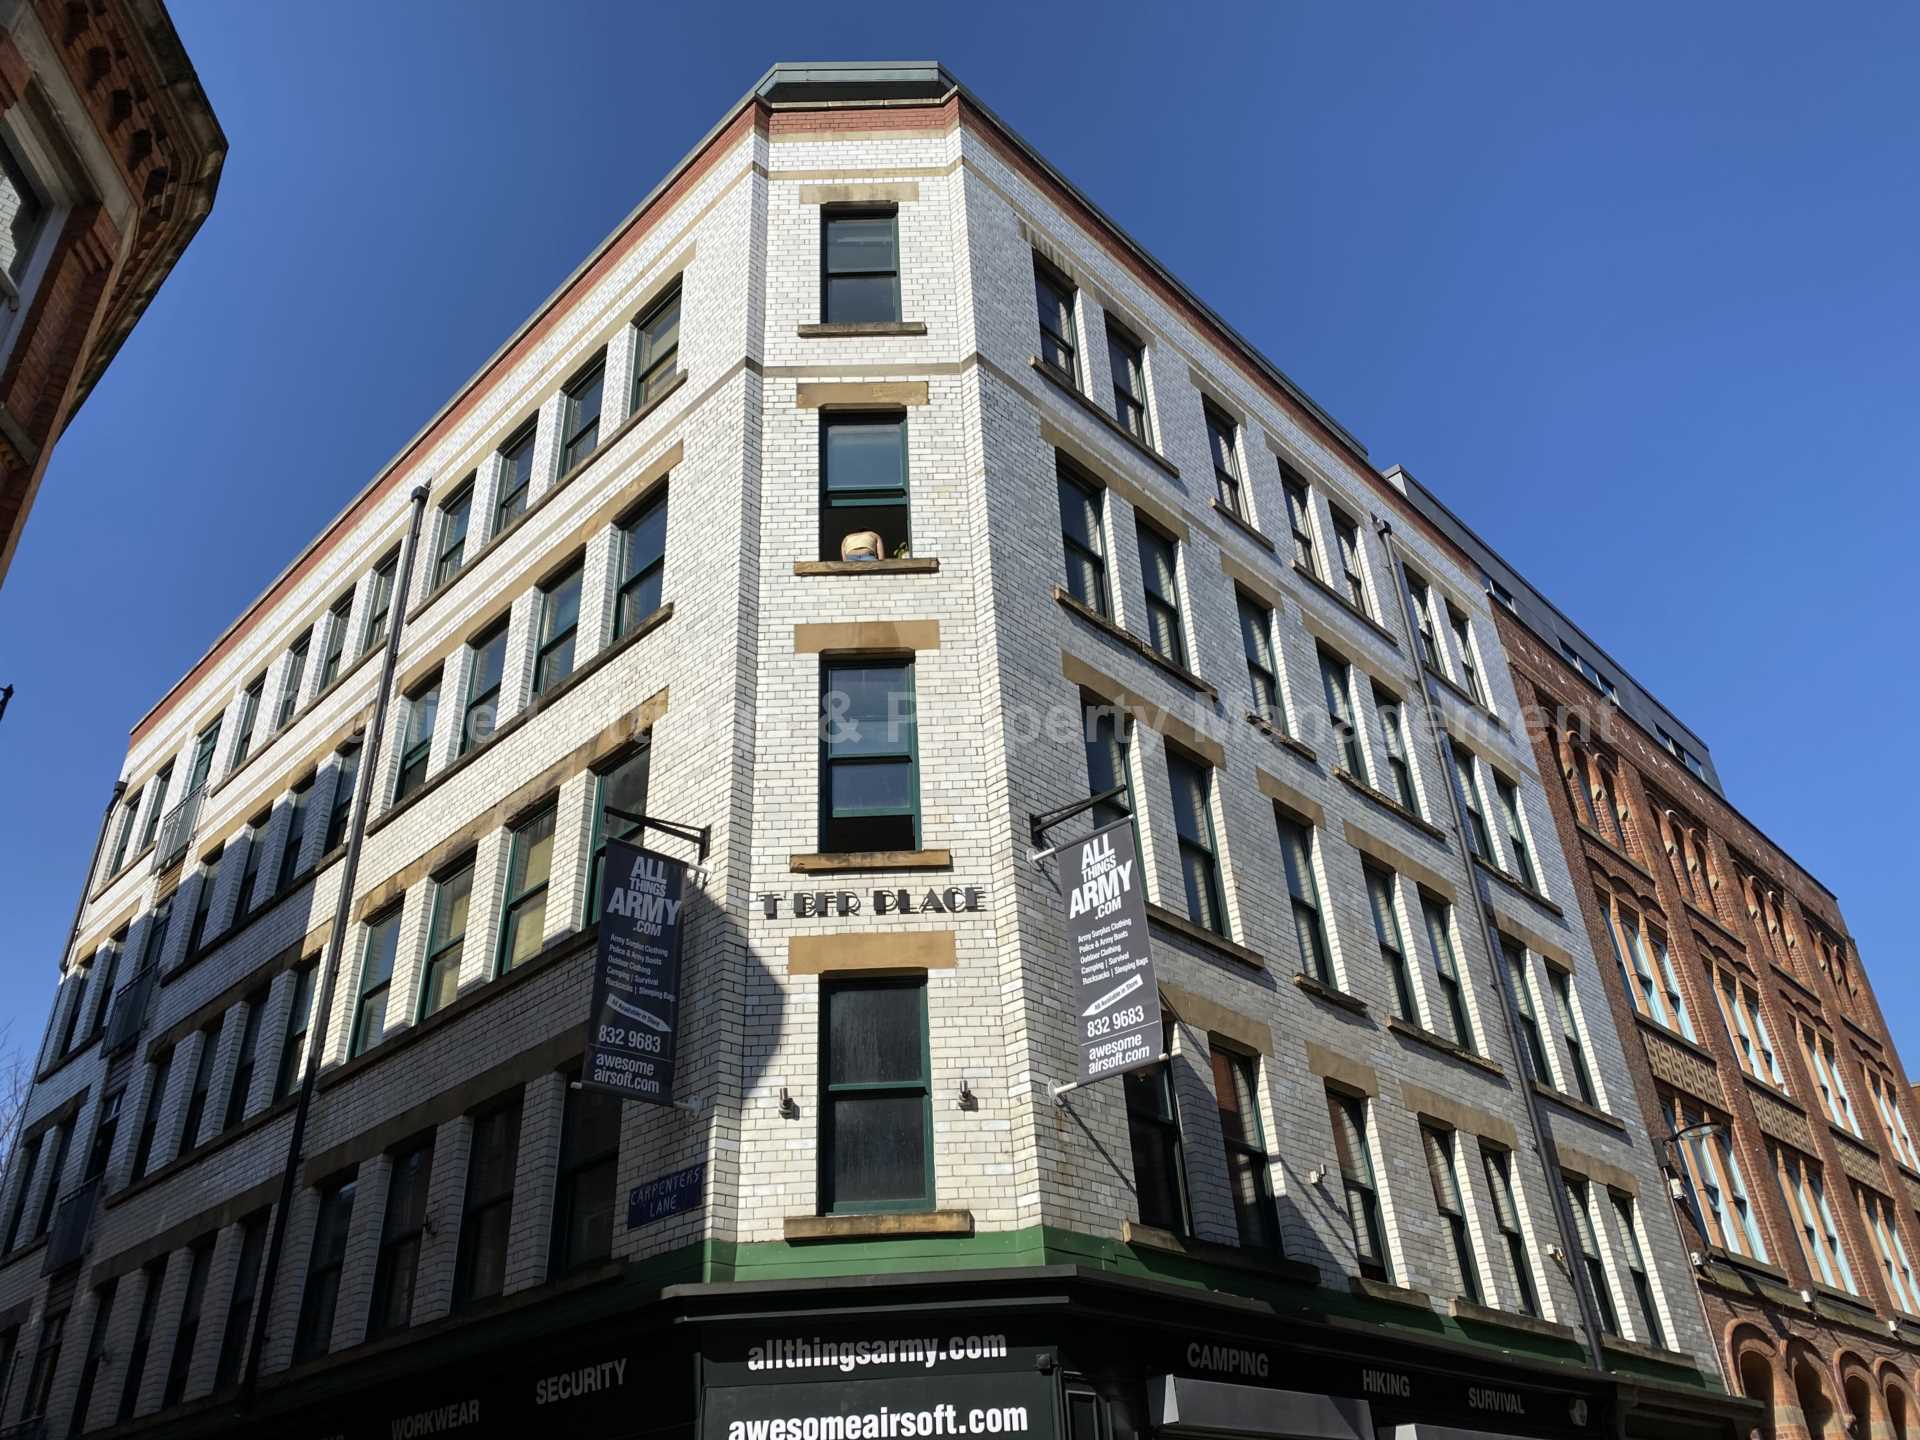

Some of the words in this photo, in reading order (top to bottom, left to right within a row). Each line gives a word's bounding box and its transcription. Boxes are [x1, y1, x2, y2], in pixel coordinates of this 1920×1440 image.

[1081, 832, 1115, 869] ALL
[631, 855, 667, 884] ALL
[1081, 855, 1117, 883] THINGS
[629, 876, 667, 897] THINGS
[873, 886, 988, 916] PLACE
[1069, 859, 1133, 920] ARMY
[606, 887, 682, 926] ARMY
[1095, 896, 1123, 920] .COM
[632, 920, 663, 937] .COM
[1077, 933, 1092, 944] Army
[1110, 918, 1132, 931] Clothing
[1087, 1015, 1111, 1038] 832
[1112, 1005, 1145, 1030] 9683
[599, 1024, 625, 1045] 832
[628, 1030, 661, 1053] 9683
[1089, 1033, 1142, 1061] awesome
[596, 1053, 655, 1076] awesome
[1088, 1044, 1150, 1075] airsoft.com
[594, 1068, 660, 1094] airsoft.com
[650, 1194, 678, 1217] LANE
[748, 1334, 1008, 1372] allthingsarmy.com
[1187, 1342, 1269, 1377] CAMPING
[536, 1357, 627, 1405] SECURITY
[1362, 1369, 1411, 1398] HIKING
[1468, 1387, 1525, 1415] SURVIVAL
[392, 1400, 480, 1440] WORKWEAR
[728, 1404, 1028, 1440] awesomeairsoft.com
